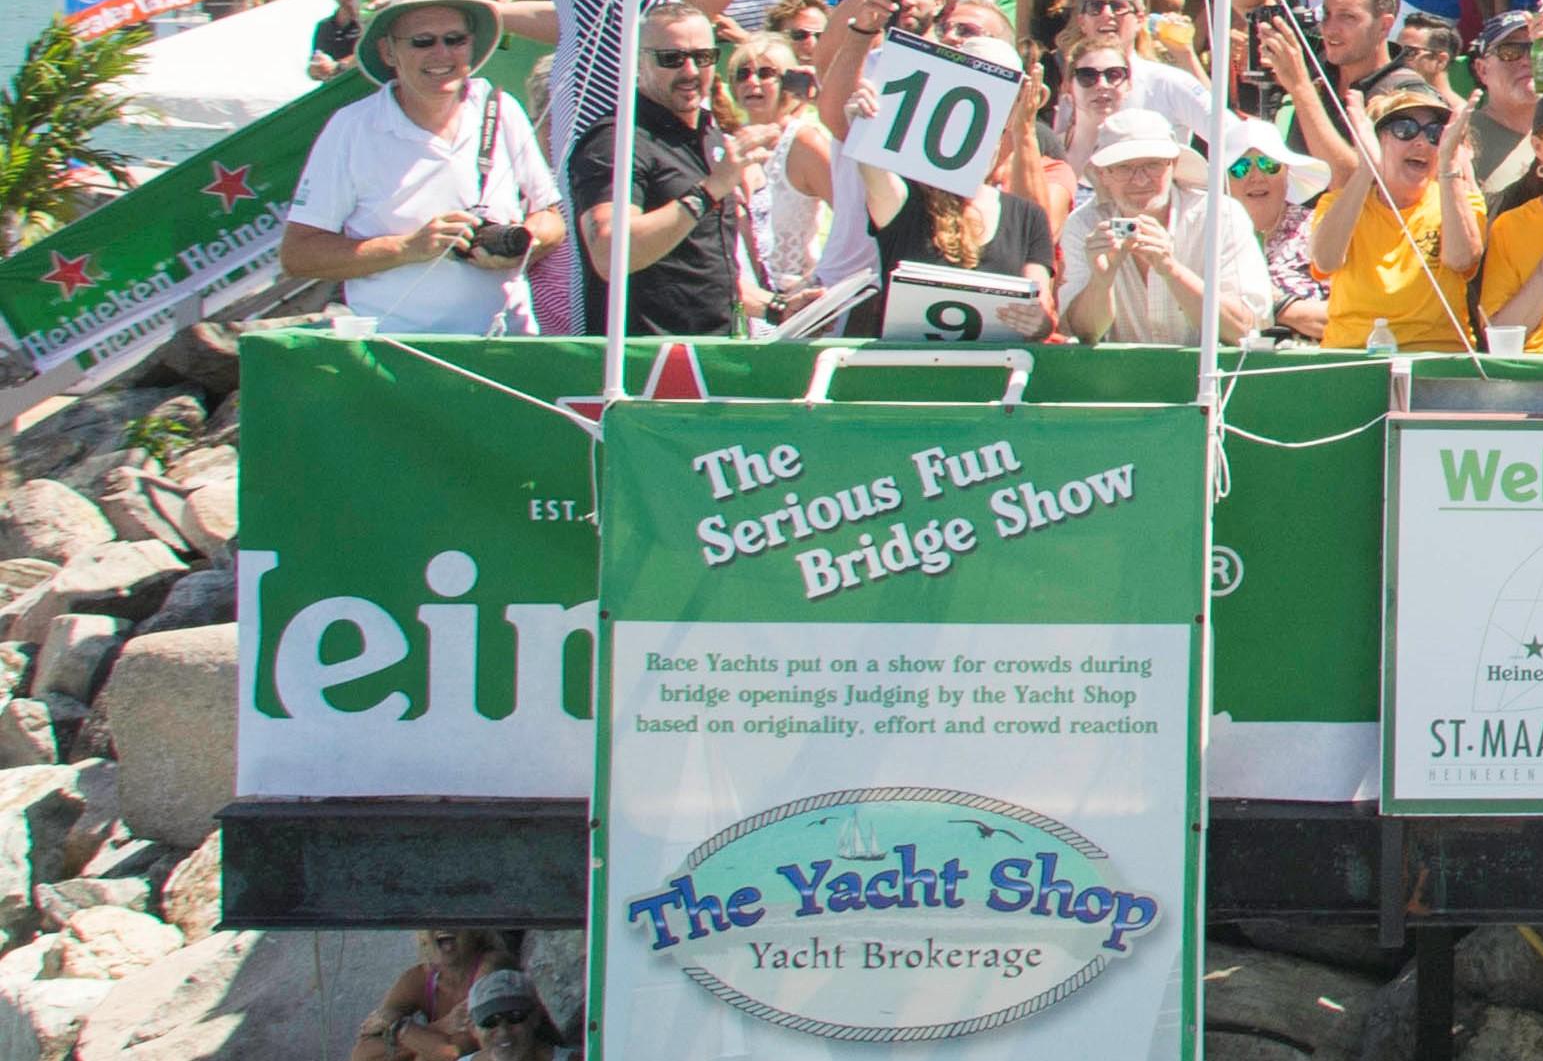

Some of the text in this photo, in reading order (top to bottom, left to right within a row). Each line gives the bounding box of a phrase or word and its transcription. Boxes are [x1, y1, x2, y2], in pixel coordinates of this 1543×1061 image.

[880, 68, 991, 171] 10
[21, 270, 175, 358] Heineken
[925, 299, 984, 341] 9
[693, 442, 804, 501] The
[529, 499, 586, 522] EST.
[696, 440, 1023, 565] Serious Fun
[796, 462, 1136, 601] Bridge Show
[646, 653, 1153, 679] Race Yachts put on a show for crowds during
[659, 683, 1137, 708] bridge openings Judging by the Yacht Shop
[636, 716, 699, 735] based
[707, 719, 735, 735] on
[873, 716, 937, 736] effort
[944, 716, 985, 736] and
[993, 716, 1062, 736] crowd
[1069, 717, 1160, 737] reaction
[1428, 767, 1537, 783] HEINEKEN
[629, 843, 1159, 953] The Yacht Shop
[750, 938, 1043, 979] Yacht Brokerage
